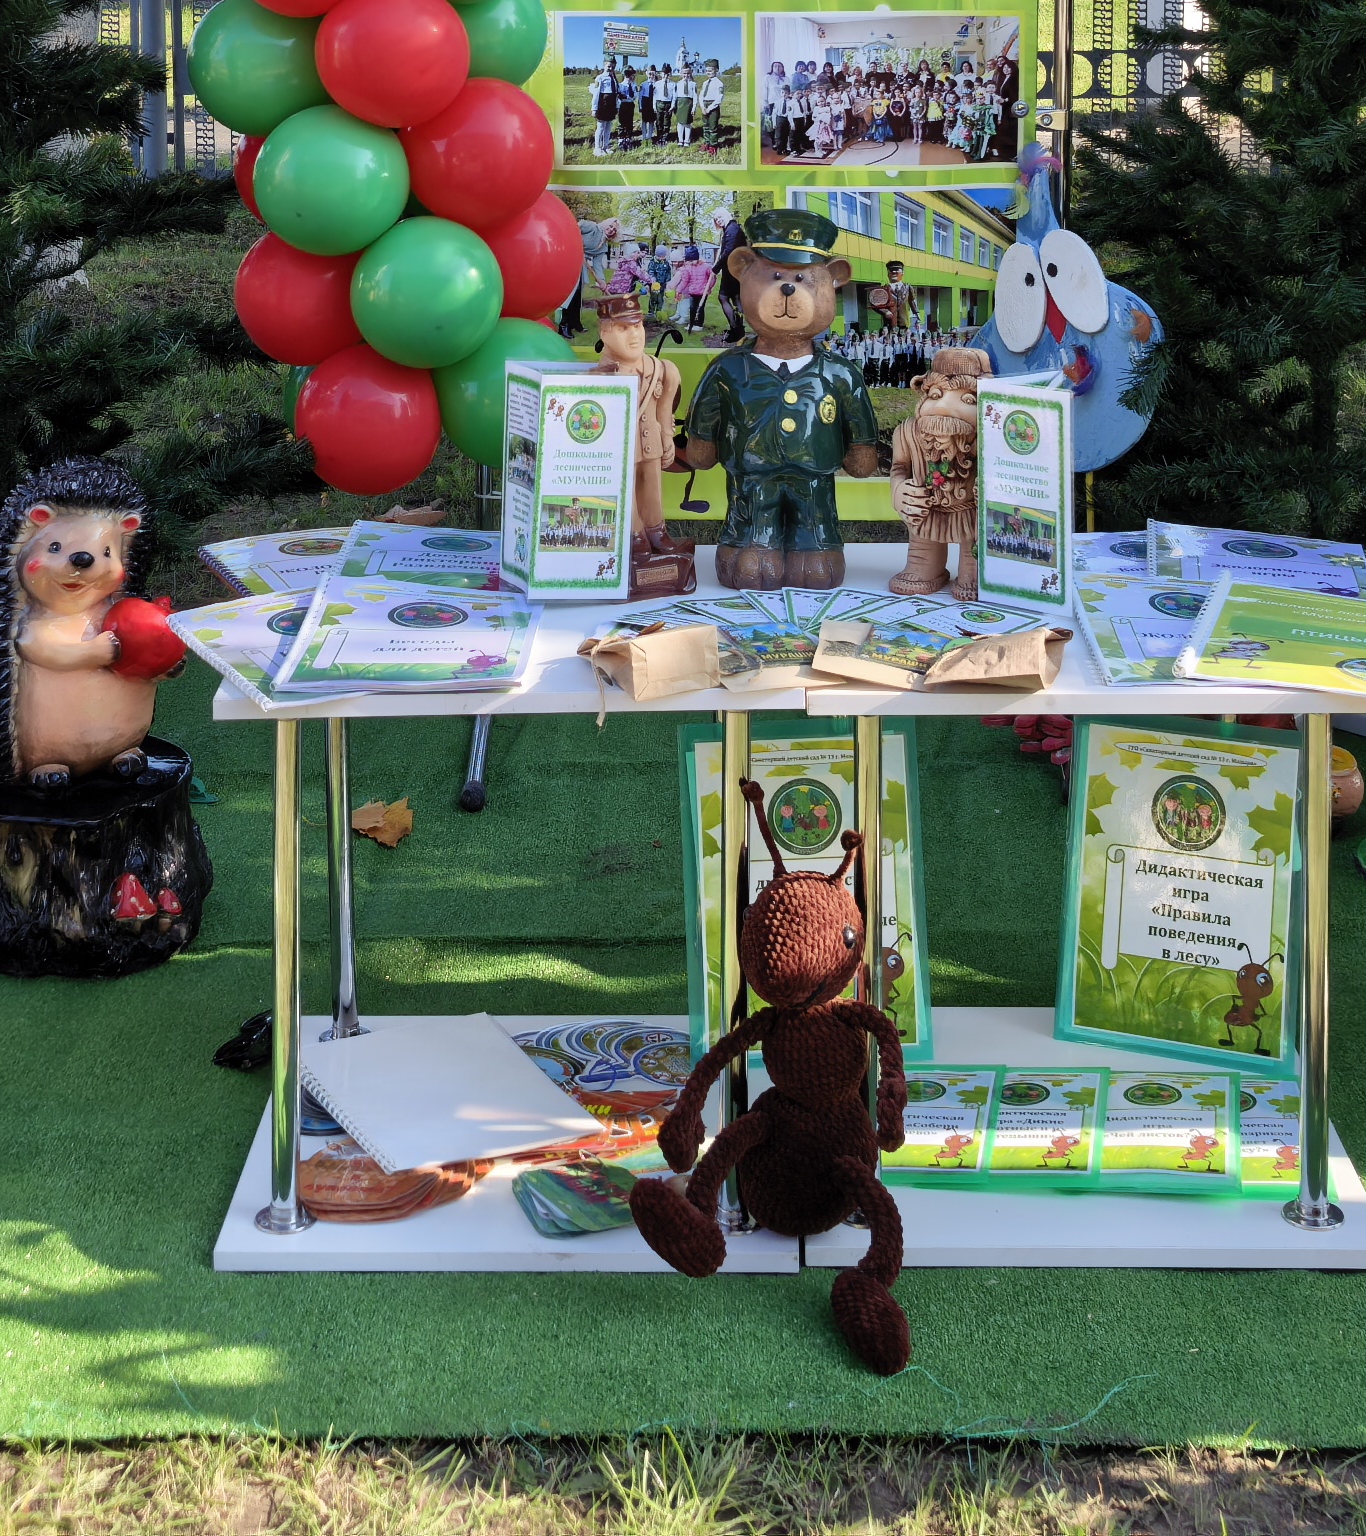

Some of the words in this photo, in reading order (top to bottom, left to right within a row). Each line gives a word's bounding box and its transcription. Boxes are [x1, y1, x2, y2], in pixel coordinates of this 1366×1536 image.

[553, 449, 613, 459] Дошкольное
[553, 464, 612, 472] лесничество
[994, 456, 1049, 473] Дошкольное
[552, 476, 612, 485] «МУРАШИ»
[995, 472, 1049, 486] лесничество
[994, 483, 1050, 499] «МУРАШИ»
[1135, 859, 1264, 889] Дидактическая
[1171, 887, 1209, 903] игра
[1151, 904, 1231, 927] «Правила
[1148, 925, 1237, 948] поведения
[1162, 948, 1171, 958] в
[1174, 951, 1220, 967] лесу»
